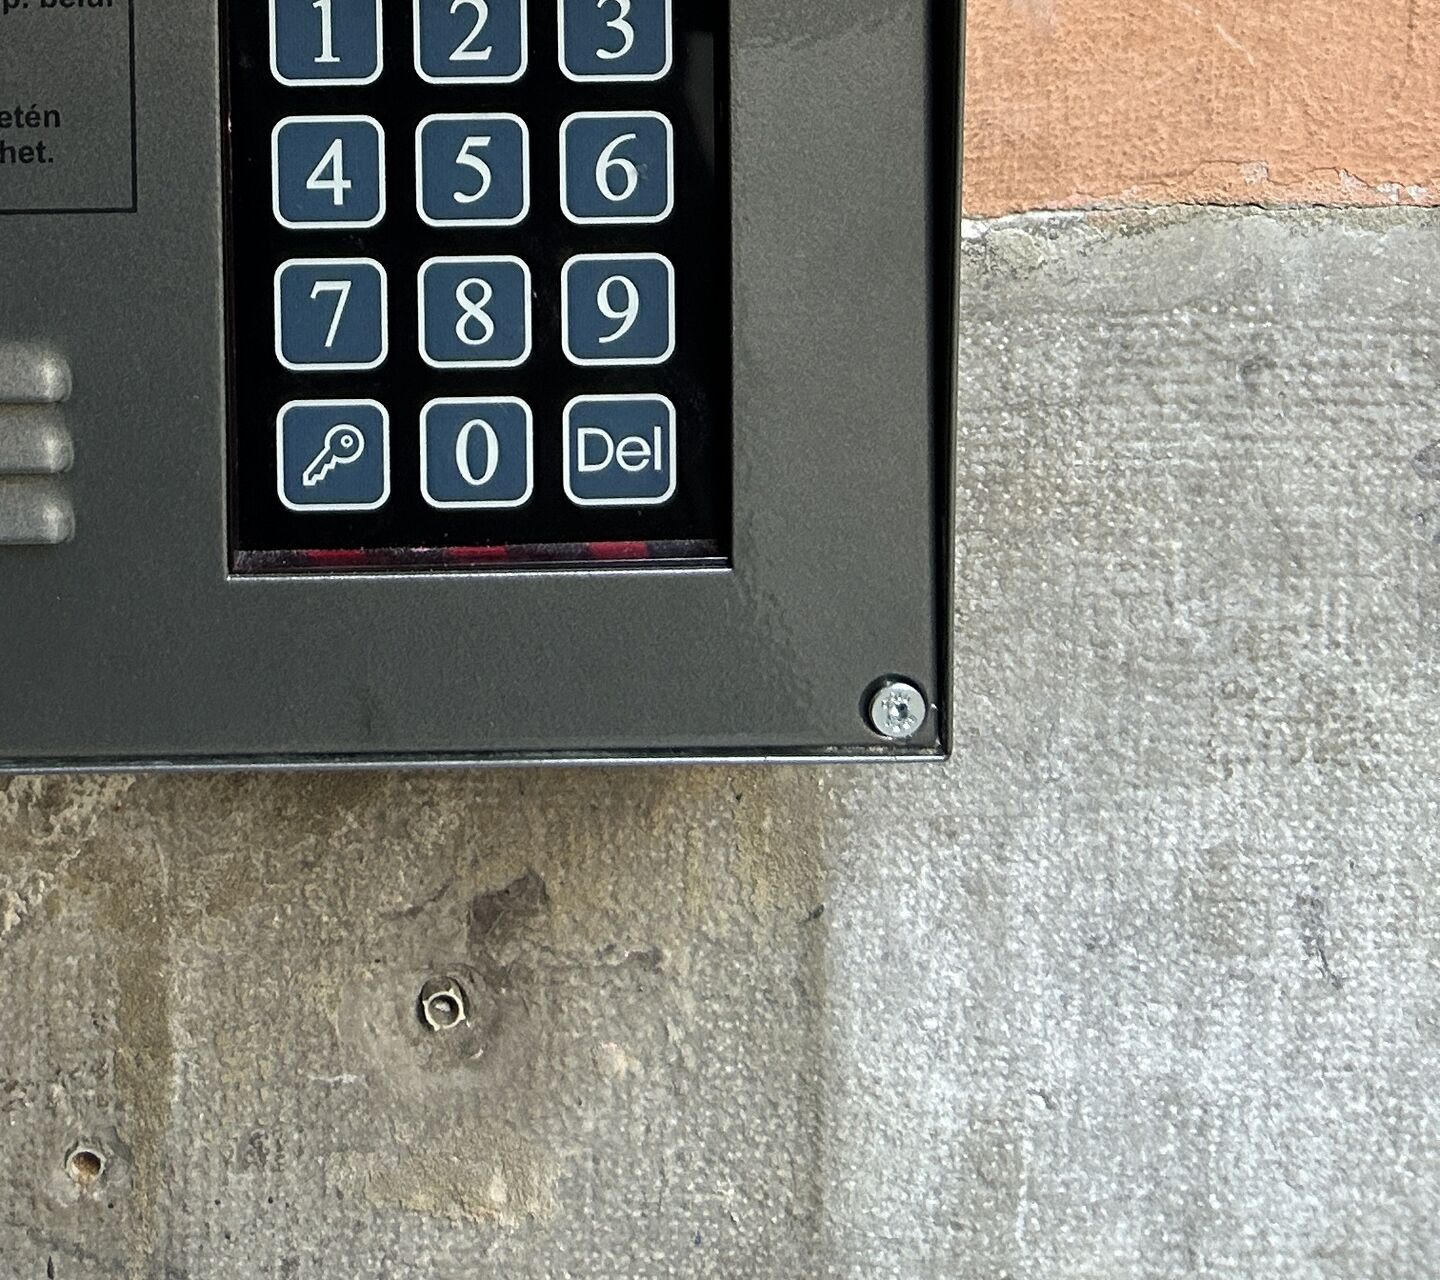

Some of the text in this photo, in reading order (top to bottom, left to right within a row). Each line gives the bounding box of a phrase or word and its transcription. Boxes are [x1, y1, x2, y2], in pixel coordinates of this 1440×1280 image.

[306, 138, 352, 206] 4
[453, 136, 492, 204] 5
[595, 133, 638, 202] 6
[310, 280, 352, 348] 7
[455, 277, 495, 346] 8
[596, 275, 640, 344] 9
[455, 418, 499, 486] 0
[577, 426, 662, 473] Del
